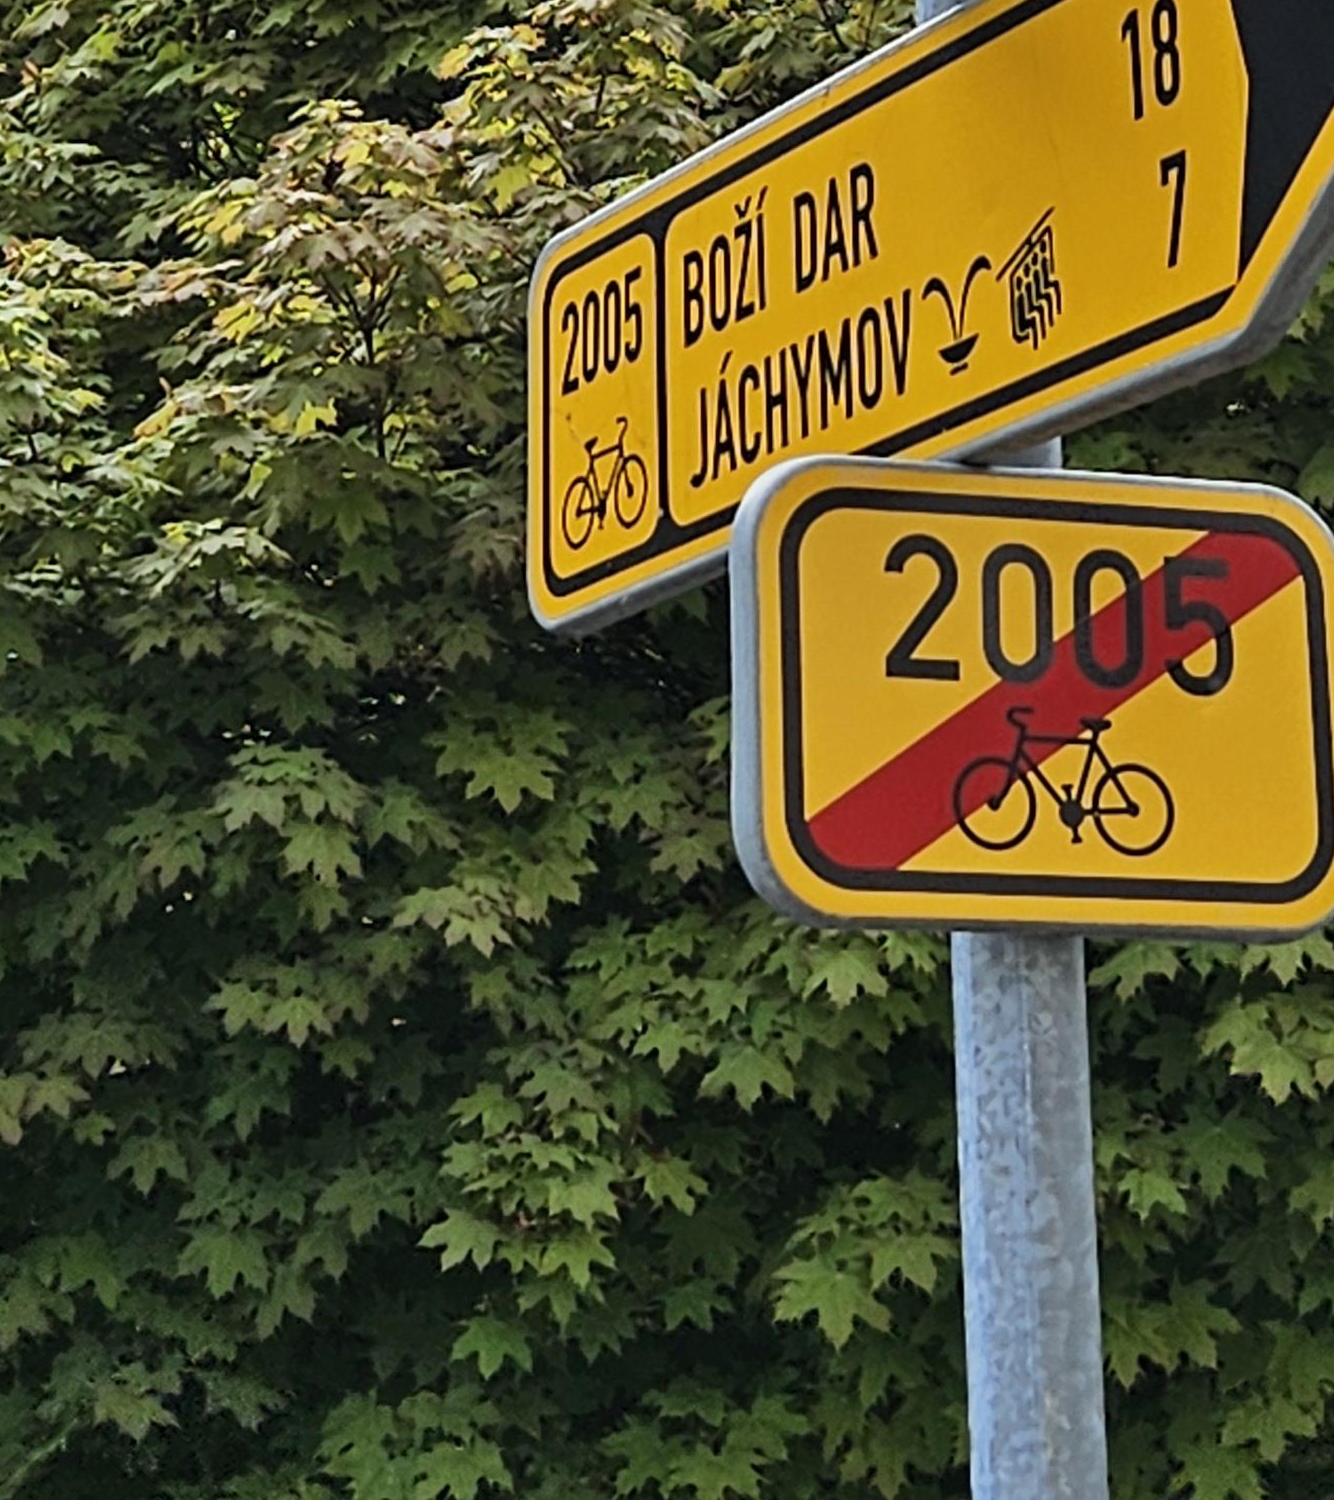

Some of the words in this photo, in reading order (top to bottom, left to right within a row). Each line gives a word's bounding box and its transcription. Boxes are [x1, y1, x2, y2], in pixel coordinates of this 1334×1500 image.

[561, 265, 644, 396] 2005
[683, 186, 770, 348] BOŽÍ
[793, 162, 879, 294] DAR
[689, 288, 912, 489] JÁCHYMOV
[1158, 149, 1188, 269] 7
[883, 533, 1235, 697] 2005
